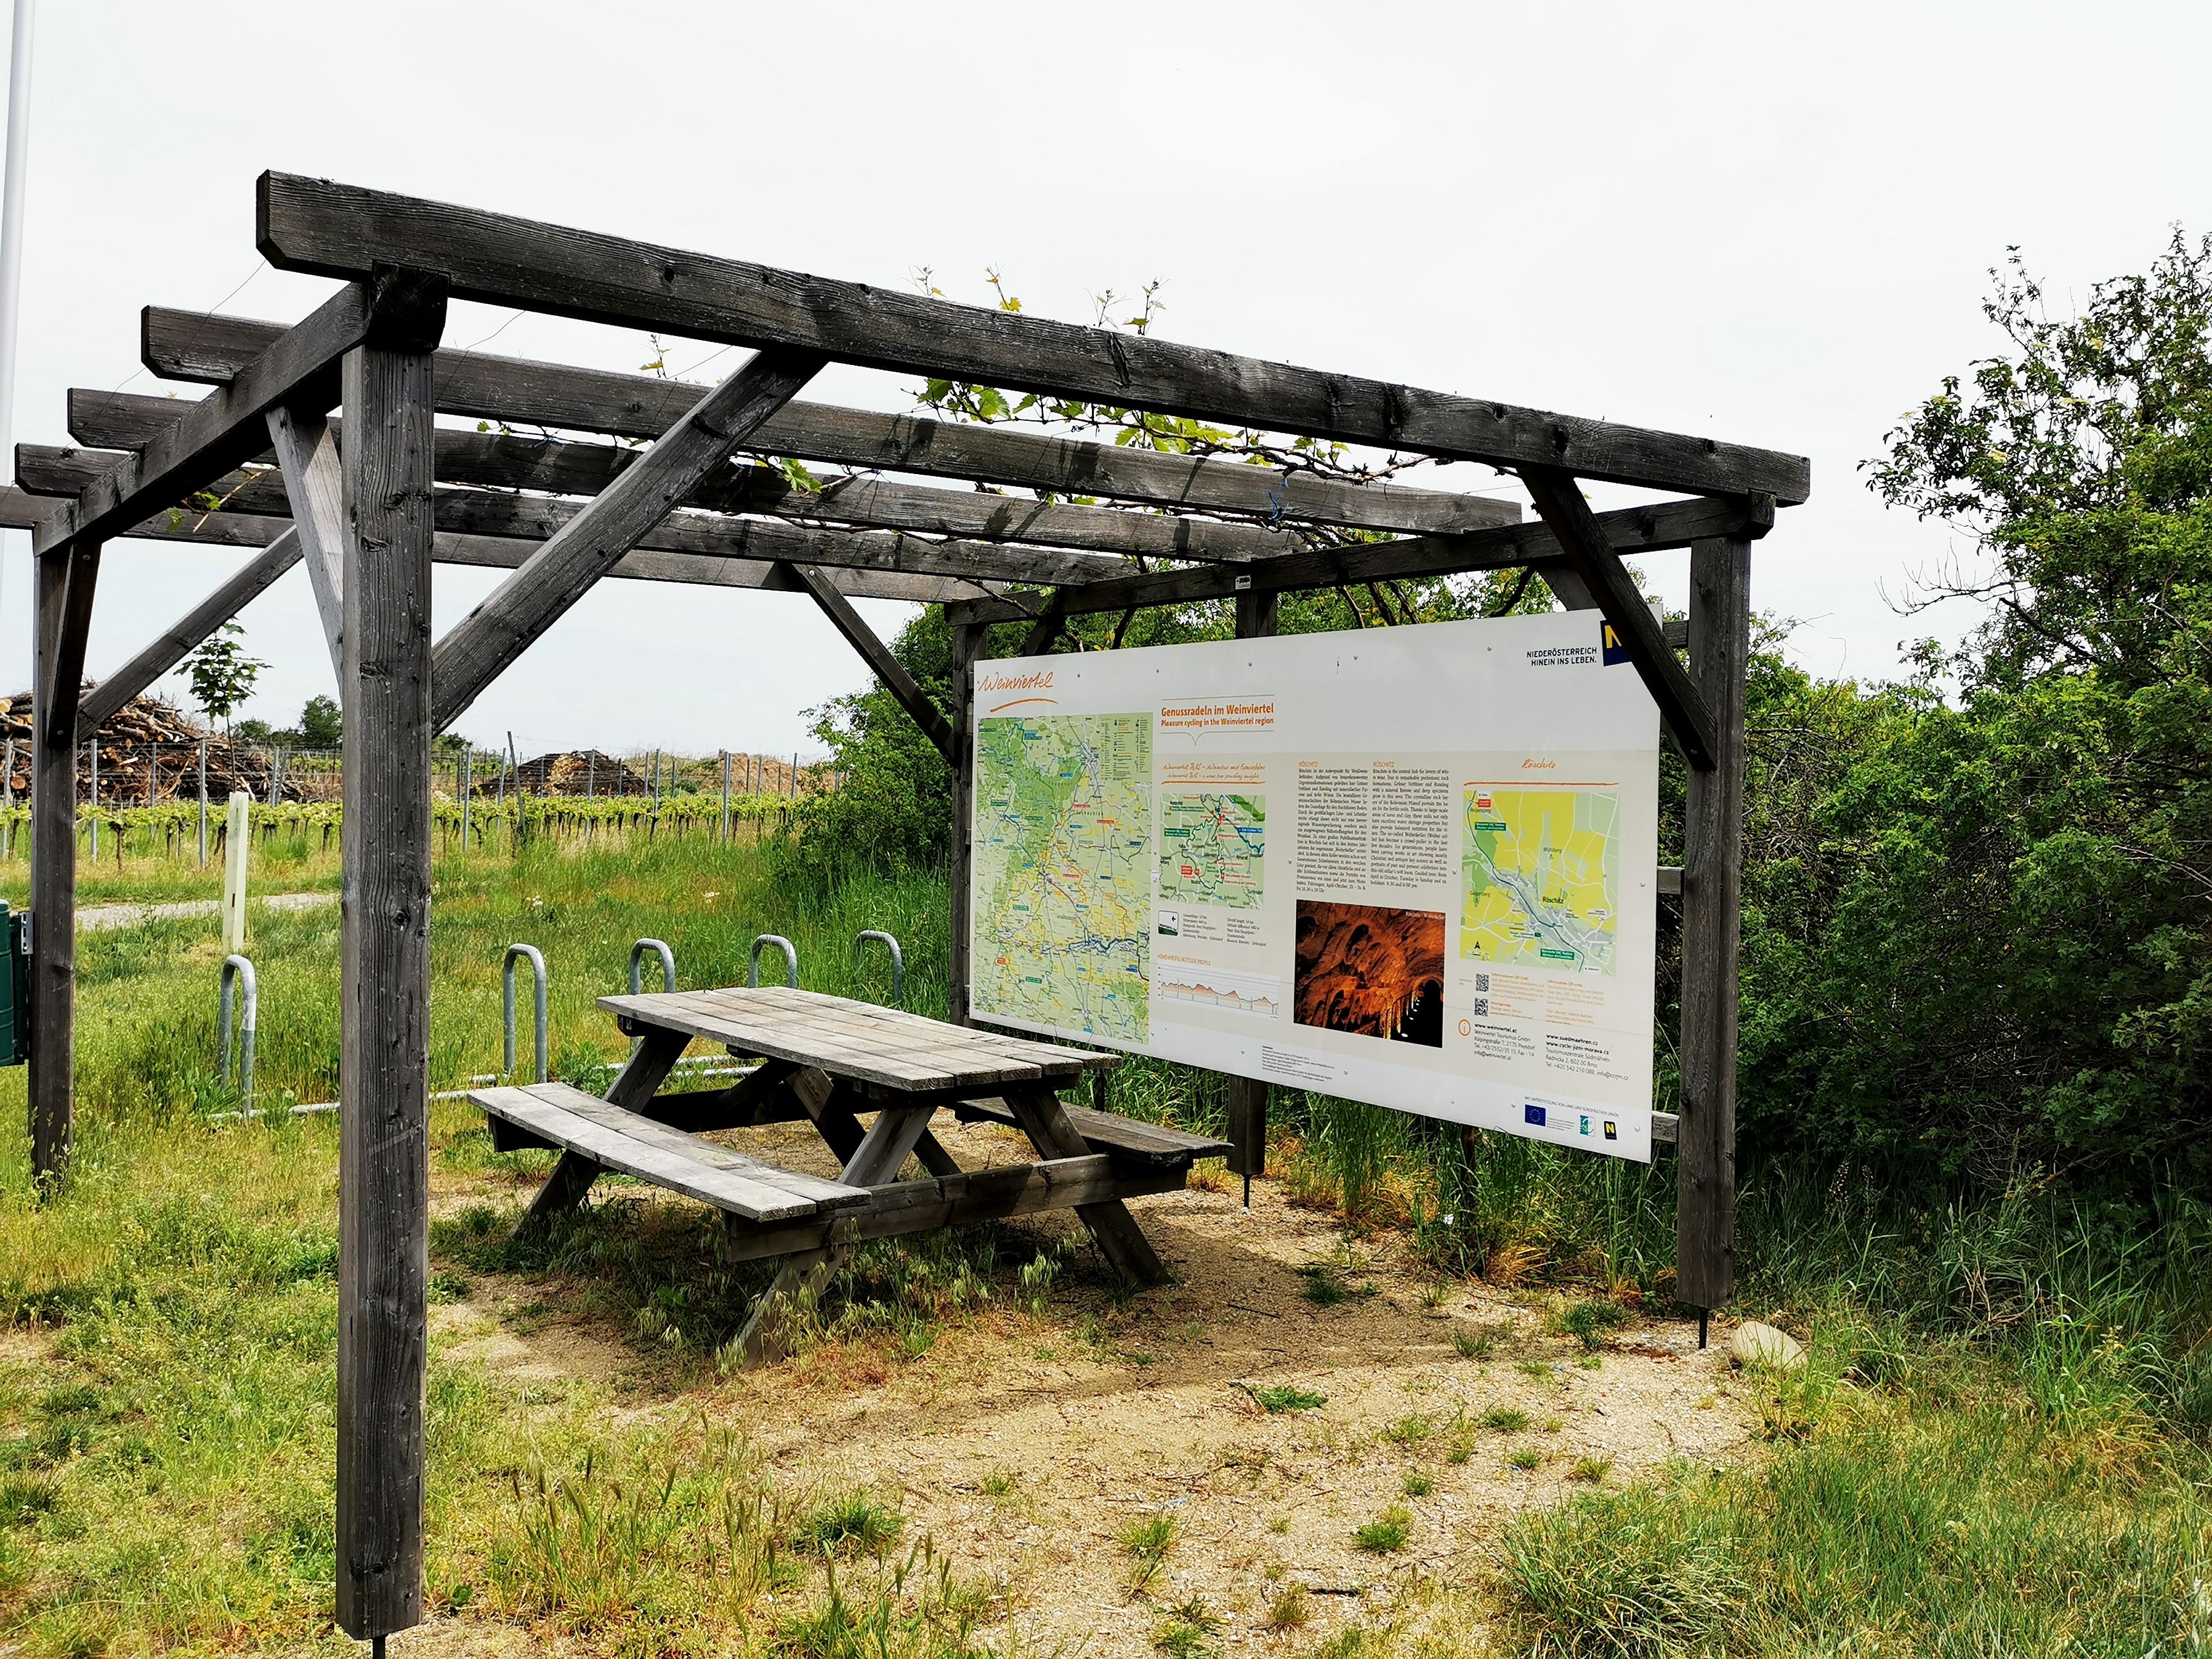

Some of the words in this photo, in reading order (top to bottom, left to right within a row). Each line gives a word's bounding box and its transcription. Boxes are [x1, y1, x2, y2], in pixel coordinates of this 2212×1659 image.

[1527, 647, 1597, 658] NIEDERÖSTERREICH
[978, 671, 1054, 691] Weinviertel
[1161, 705, 1213, 717] Genussradeln
[1214, 706, 1224, 715] im
[1226, 703, 1274, 714] Weinviertel
[1184, 719, 1202, 728] cycling
[1221, 717, 1254, 725] Weinviertel
[1255, 717, 1274, 726] region
[1521, 758, 1556, 769] Röschitz
[1543, 896, 1564, 905] Röschitz
[1474, 1024, 1517, 1033] www.weinviertel.at
[1546, 1034, 1598, 1045] www.suedmaehren.cz
[1606, 1123, 1615, 1134] N
